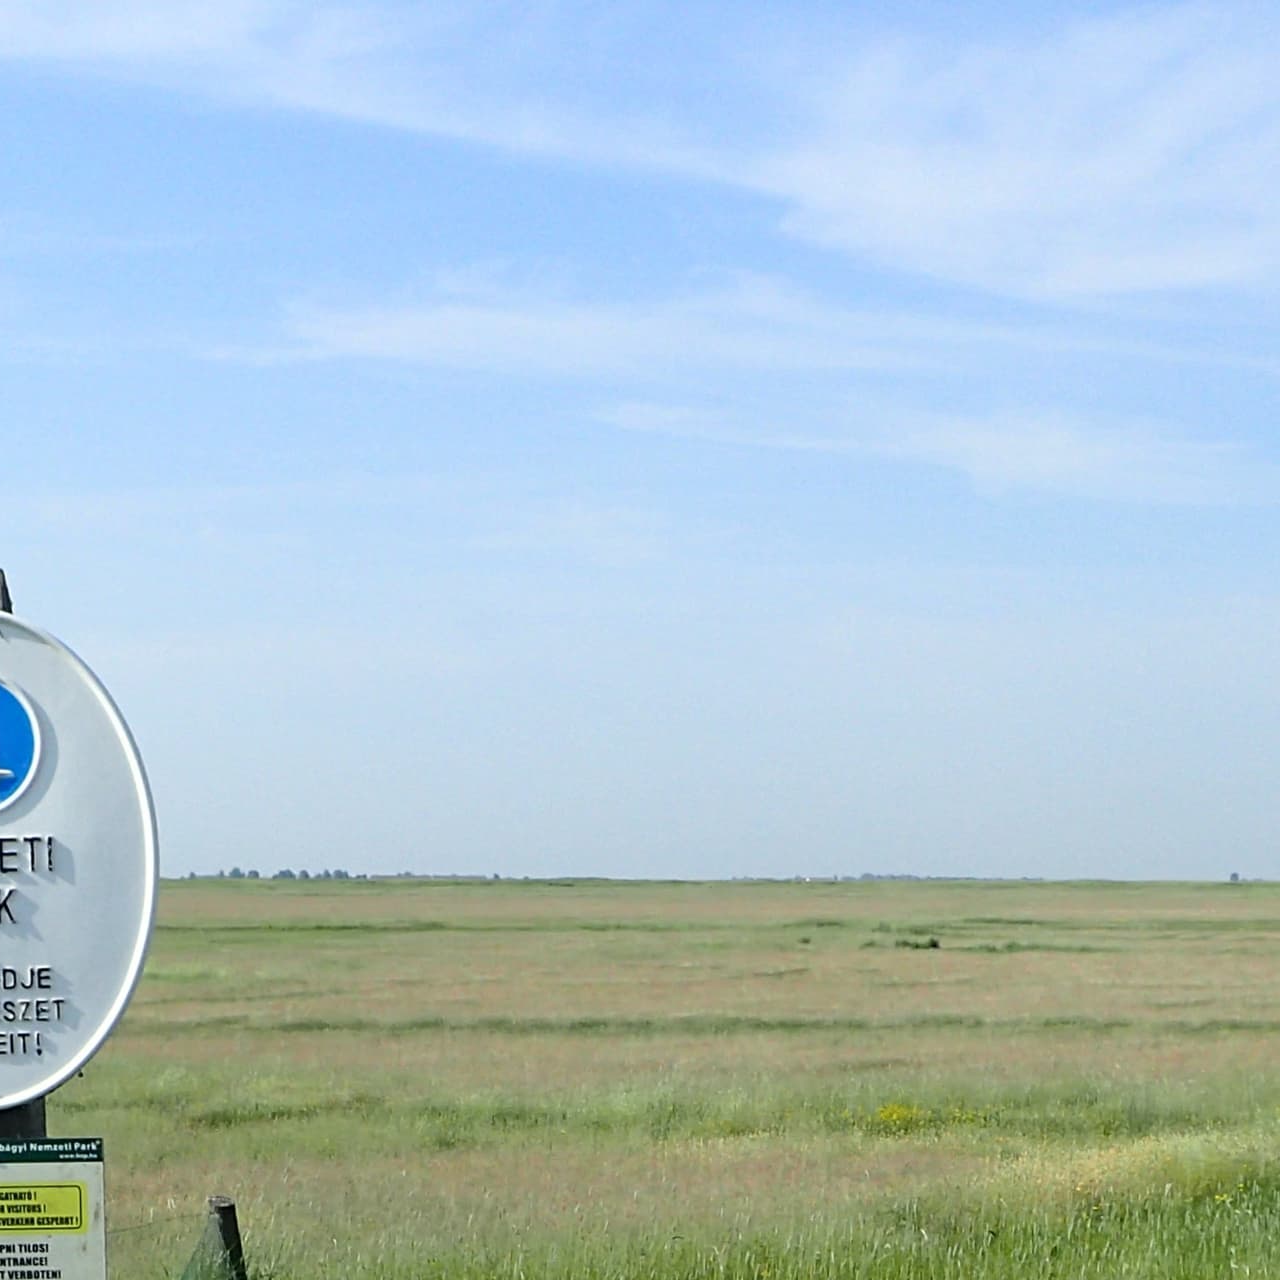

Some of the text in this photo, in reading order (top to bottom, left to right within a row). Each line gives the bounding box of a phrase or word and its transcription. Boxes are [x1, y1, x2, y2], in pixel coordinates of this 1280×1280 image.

[29, 1142, 72, 1152] Nemzeti
[74, 1141, 97, 1151] Park
[8, 1269, 62, 1280] VERBOTEN!
